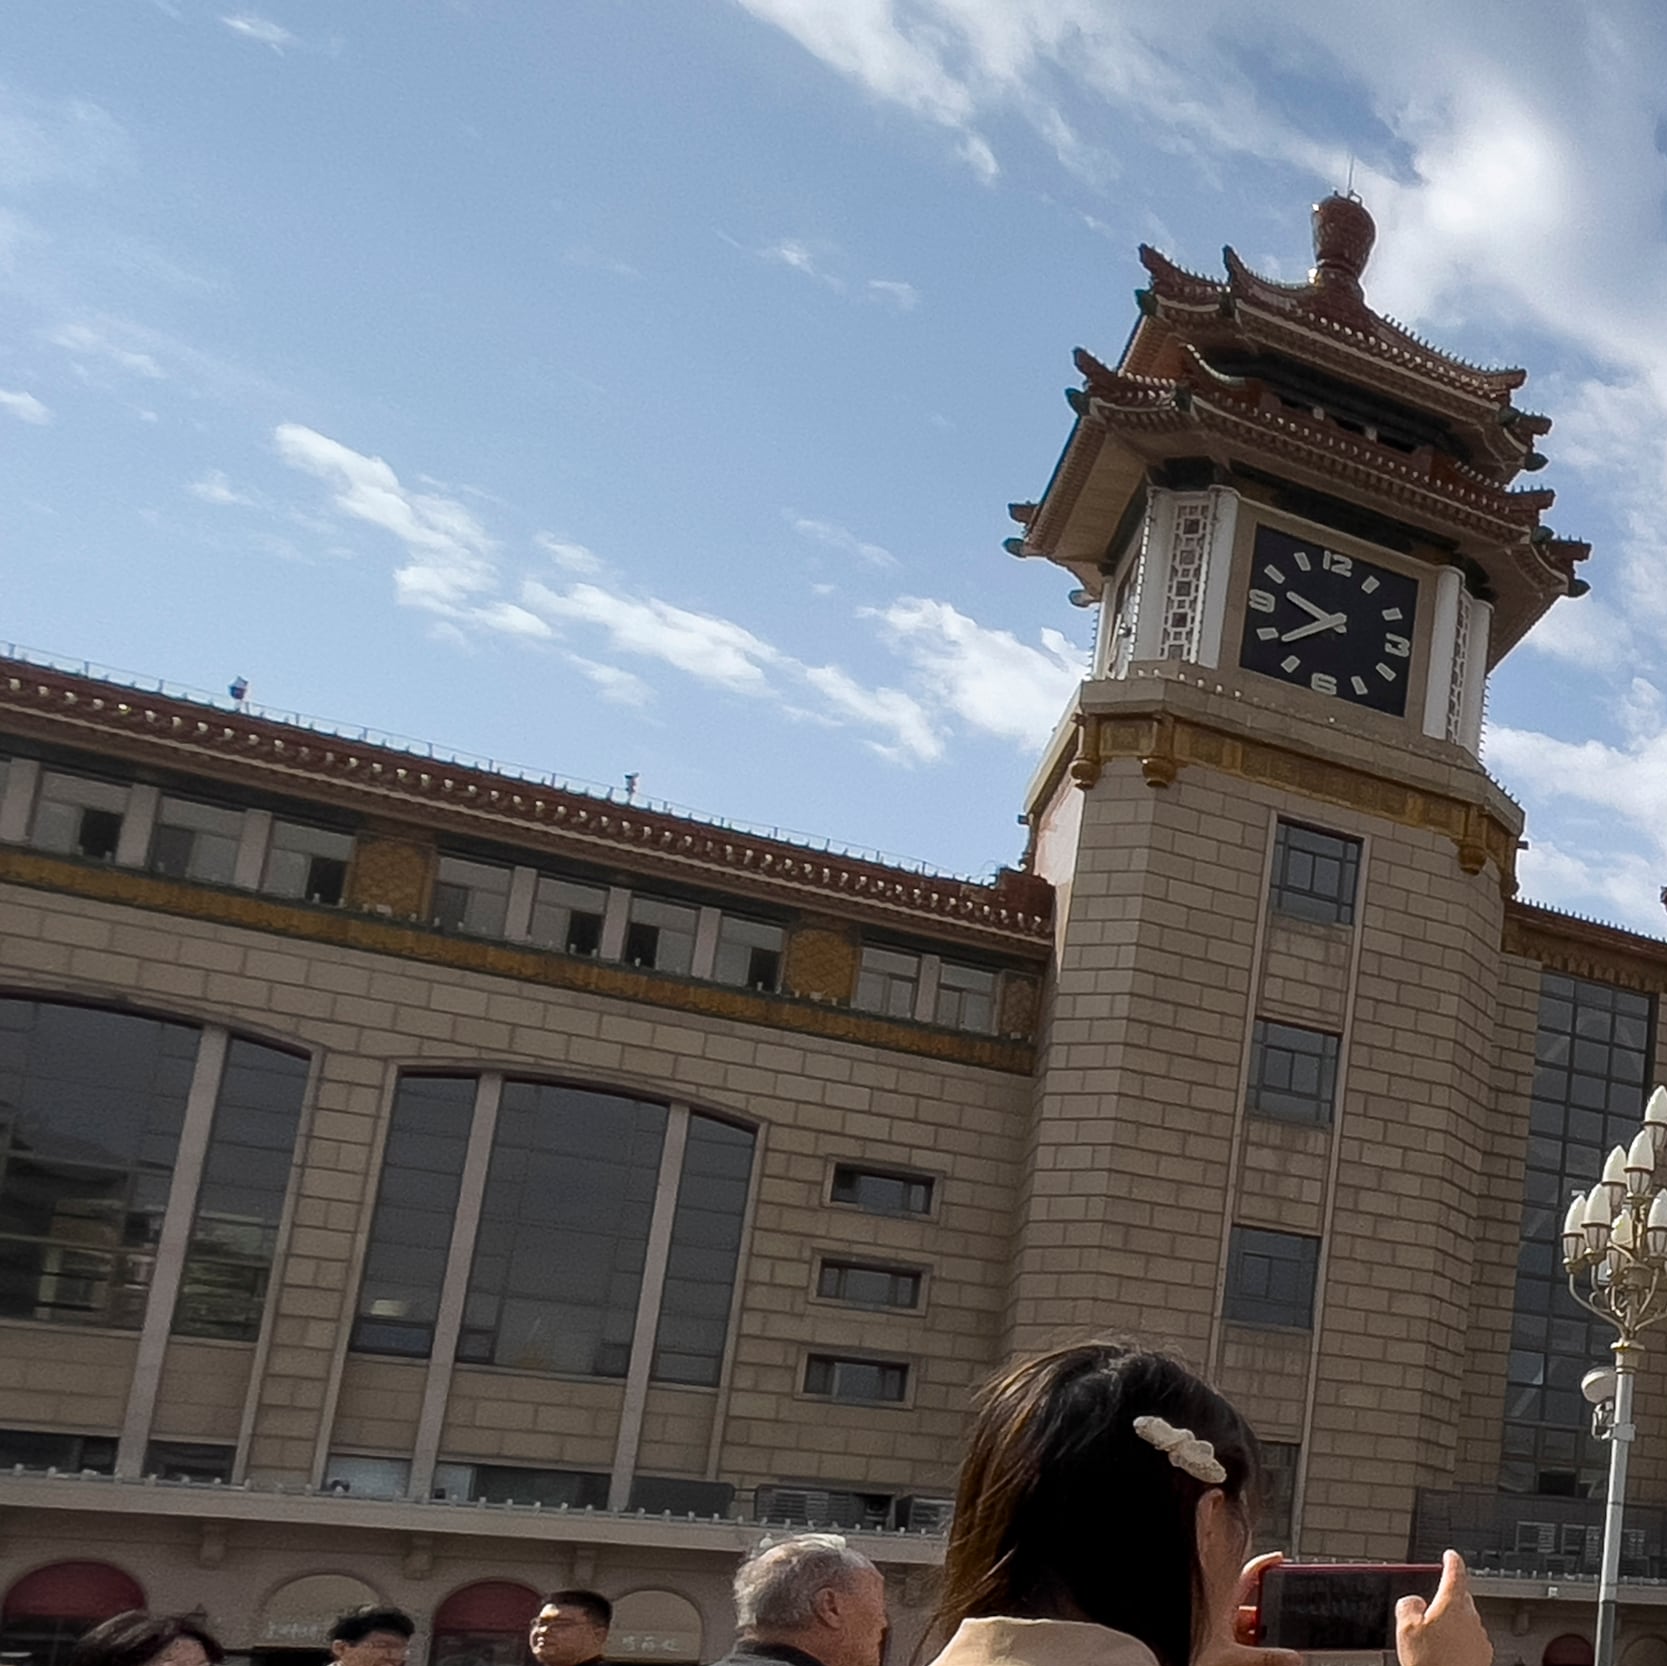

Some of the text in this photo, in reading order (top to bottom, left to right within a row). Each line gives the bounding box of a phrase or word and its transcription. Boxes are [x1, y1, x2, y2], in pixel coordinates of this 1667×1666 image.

[1322, 550, 1353, 578] 12
[1249, 588, 1276, 613] 9
[1384, 632, 1410, 658] 3
[1310, 672, 1338, 696] 6
